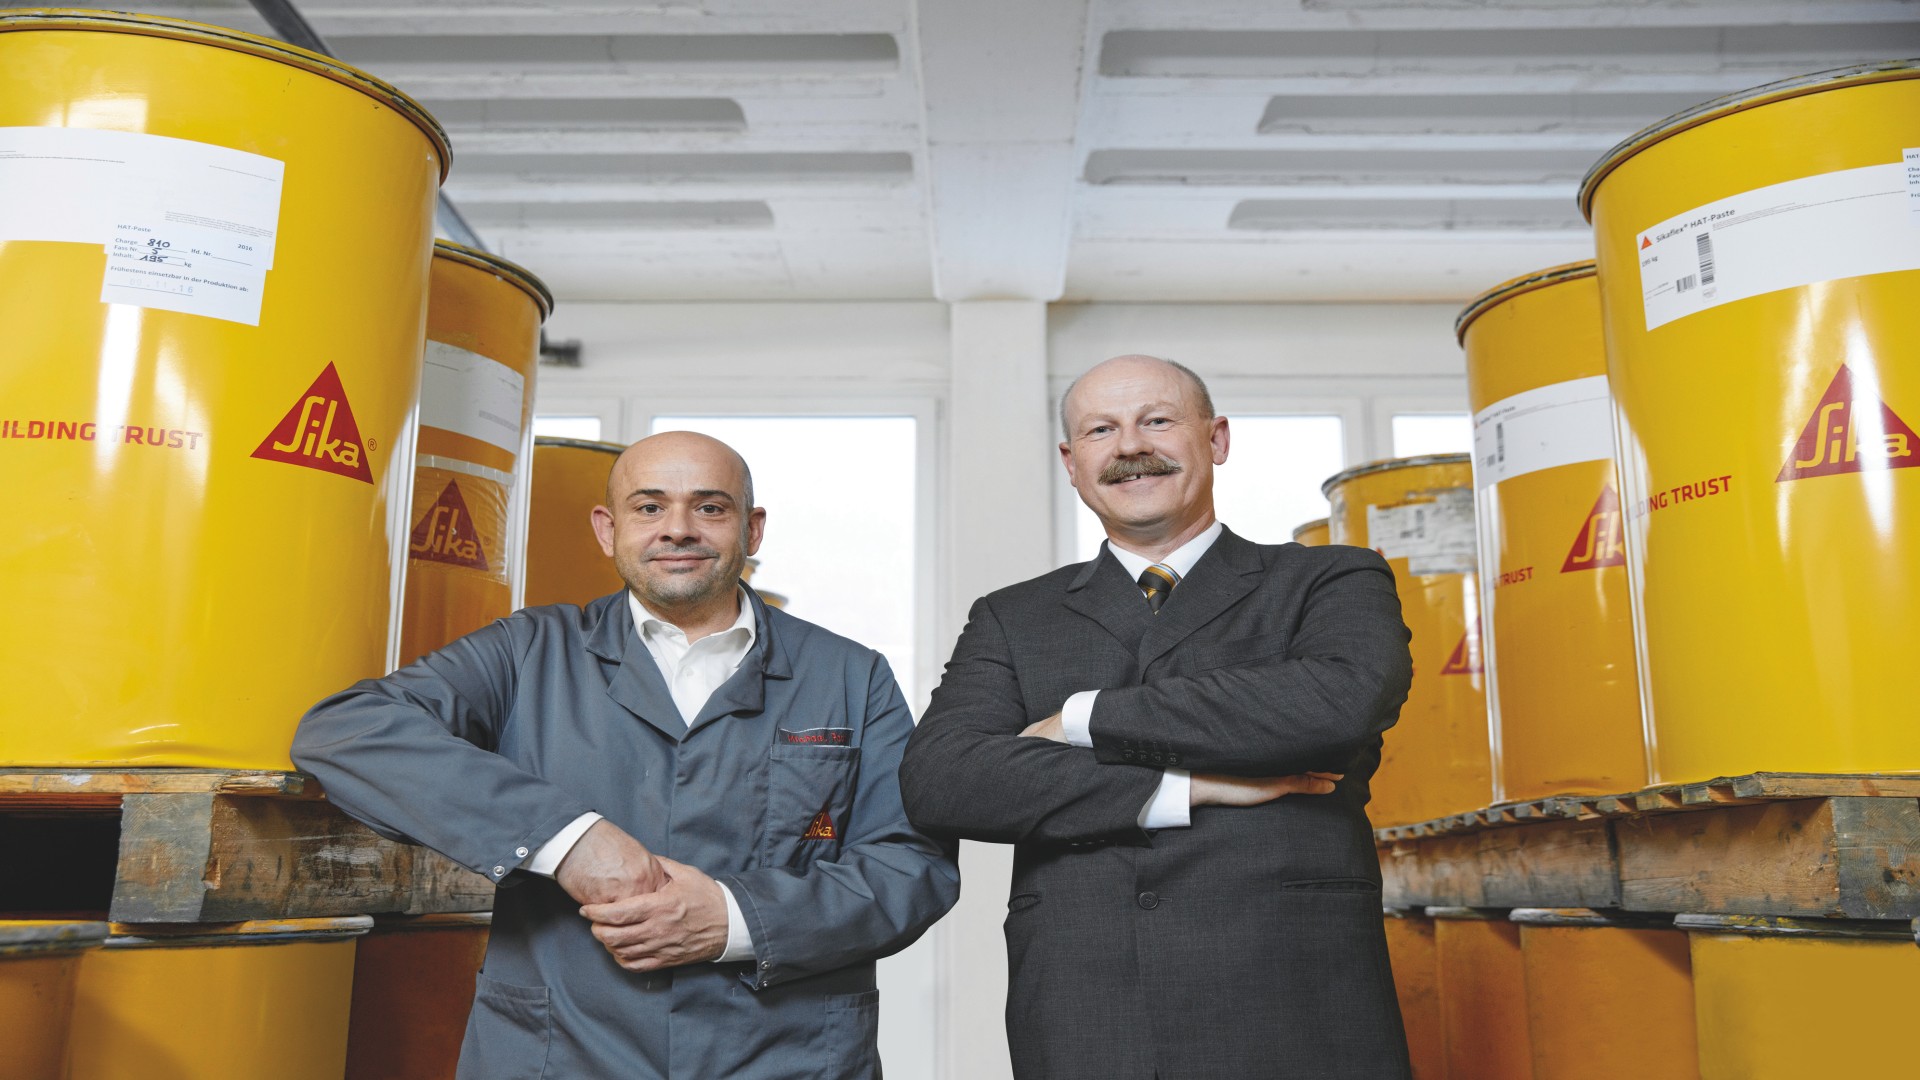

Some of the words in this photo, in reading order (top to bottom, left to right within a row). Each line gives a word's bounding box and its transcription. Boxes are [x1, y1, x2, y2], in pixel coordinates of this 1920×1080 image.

[117, 224, 152, 233] HAT-Paste
[1690, 209, 1735, 229] HAT-Paste
[147, 238, 171, 248] 810
[237, 243, 253, 252] 2016
[110, 265, 147, 275] Frühestens
[148, 271, 182, 280] einsetzbar
[203, 278, 238, 290] Produktion
[0, 420, 97, 441] ILDING
[111, 424, 204, 450] TRUST
[272, 395, 360, 468] Sika
[1671, 475, 1733, 506] TRUST
[411, 506, 478, 560] Sika
[1572, 510, 1625, 563] Sik
[804, 811, 832, 837] Sika
